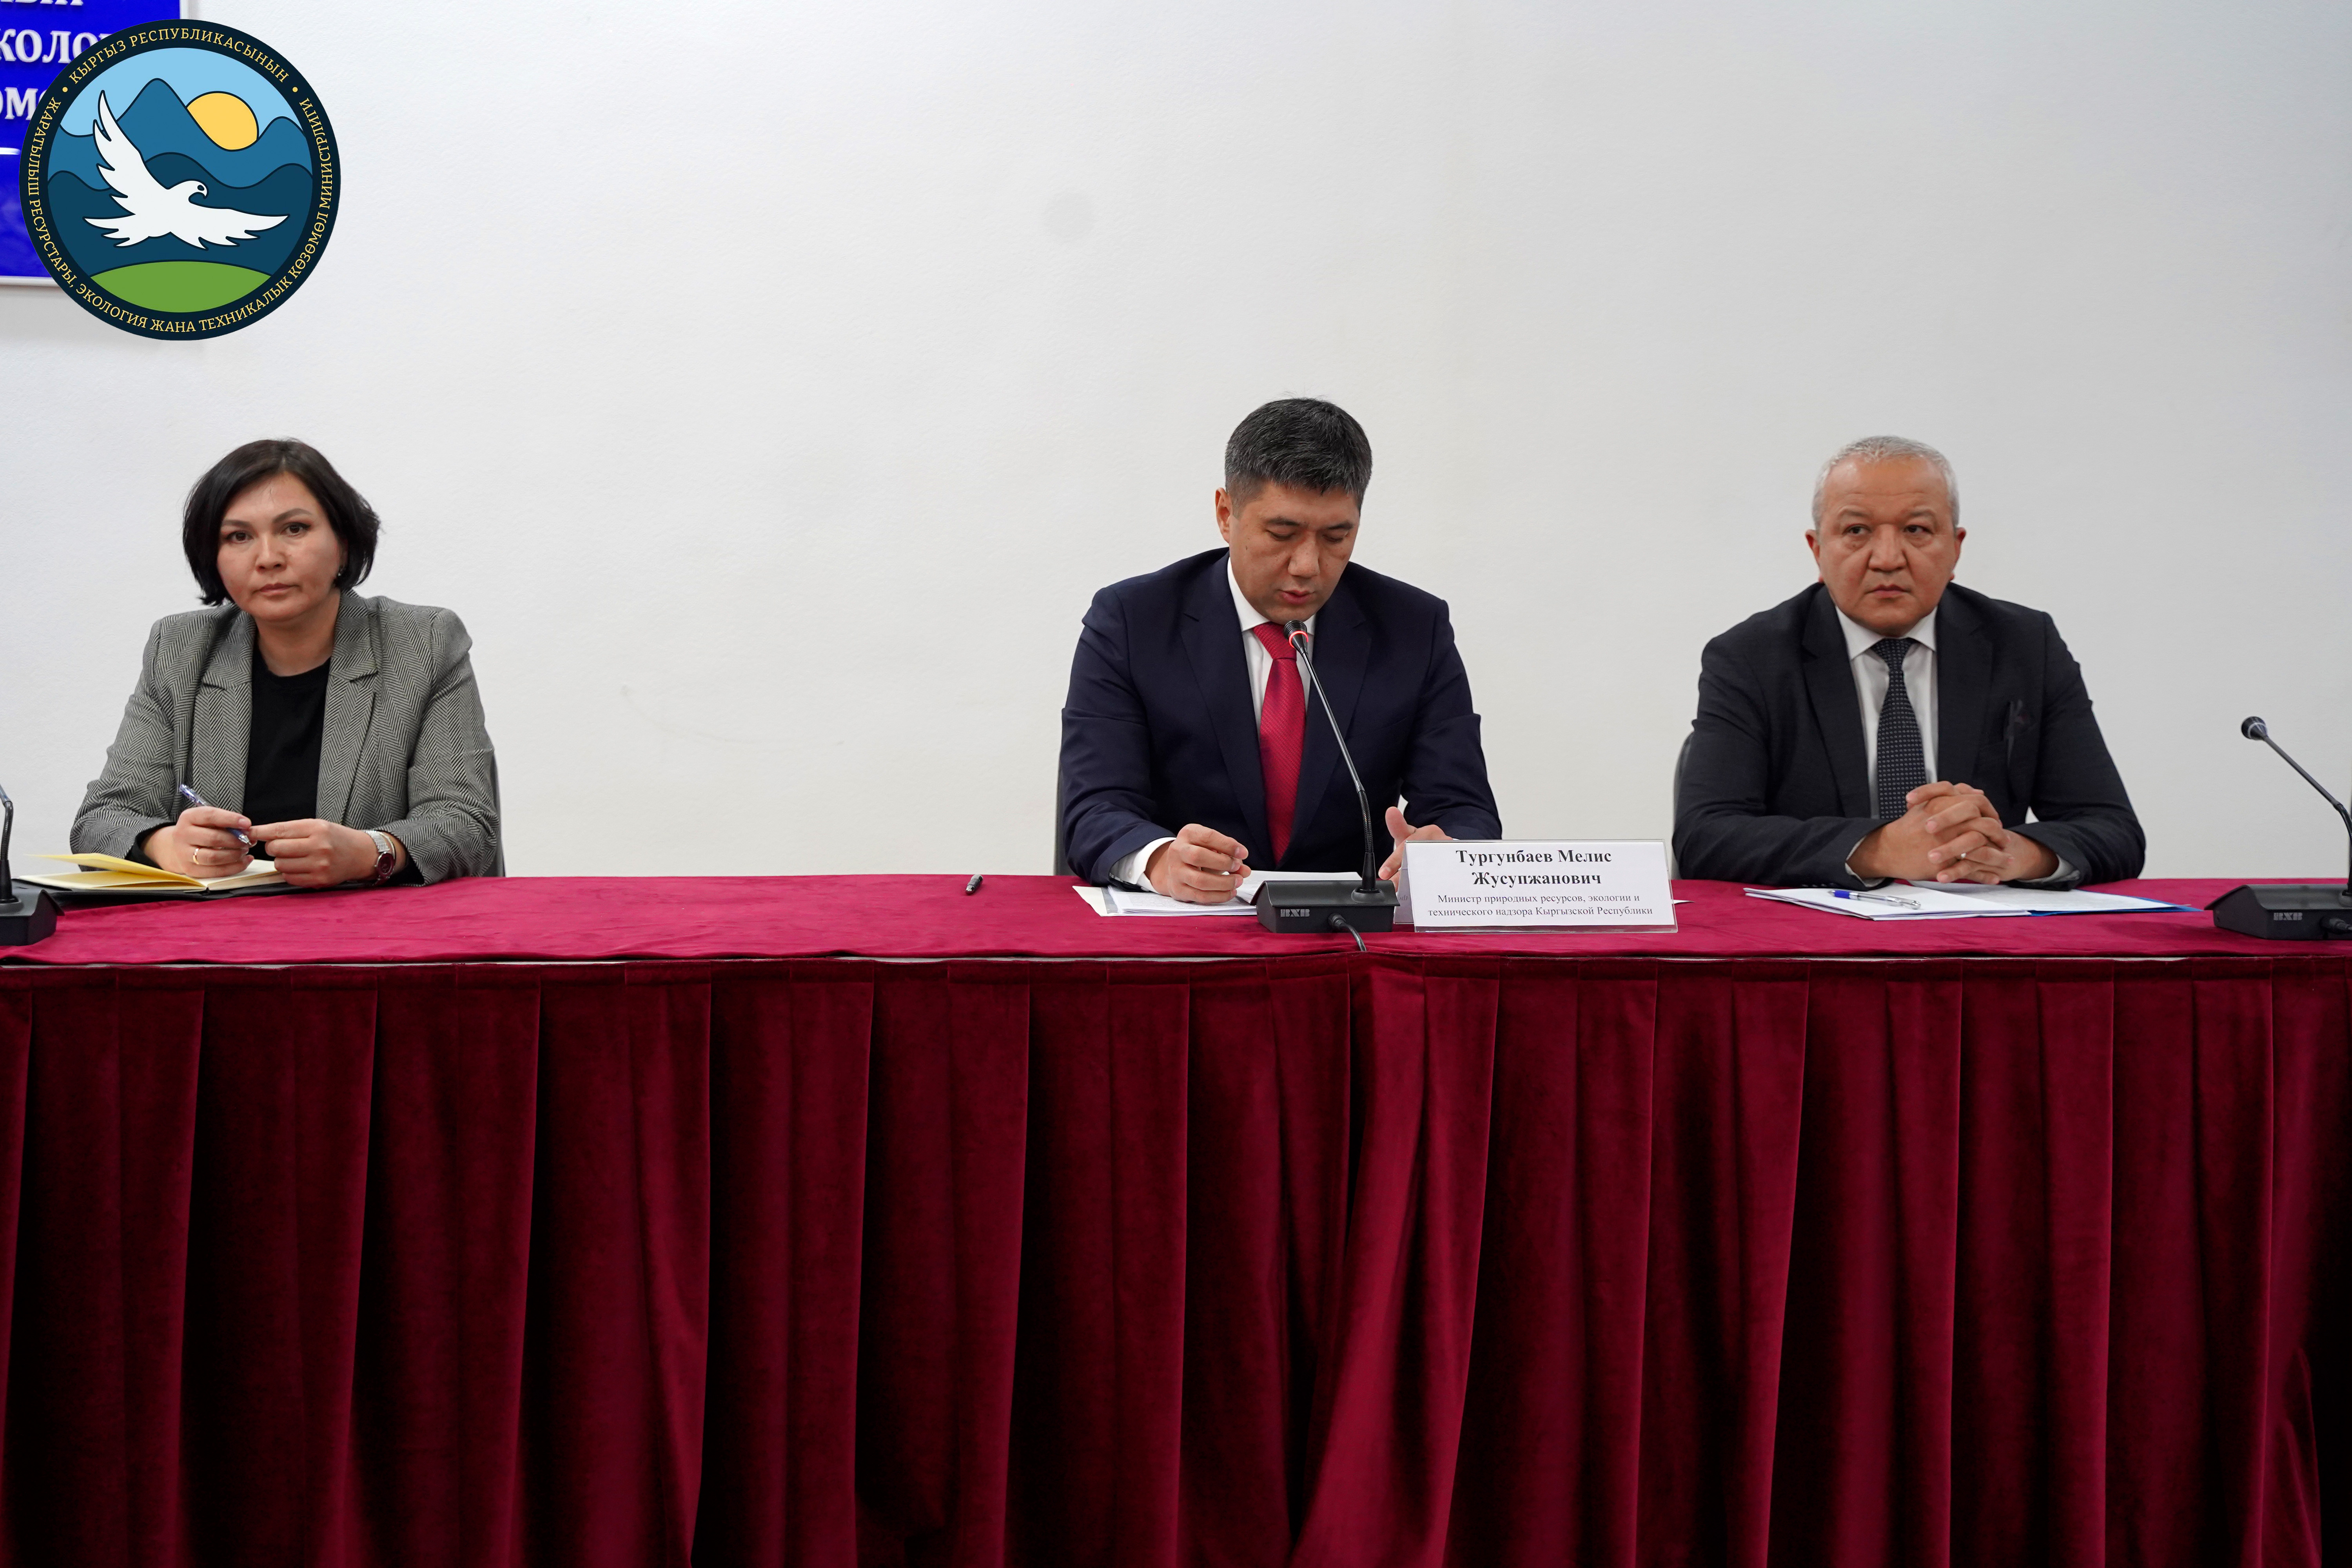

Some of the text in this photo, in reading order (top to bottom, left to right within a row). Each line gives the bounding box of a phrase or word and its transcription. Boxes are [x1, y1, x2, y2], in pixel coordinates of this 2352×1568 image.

[1456, 850, 1612, 866] Тургунбаев Мелис
[1472, 872, 1602, 888] Жусупжанович
[1438, 895, 1481, 904] Министр
[1485, 896, 1538, 904] природных
[1541, 895, 1586, 904] ресурсов,
[1536, 907, 1594, 917] Кыргызской
[1597, 907, 1653, 916] Республики
